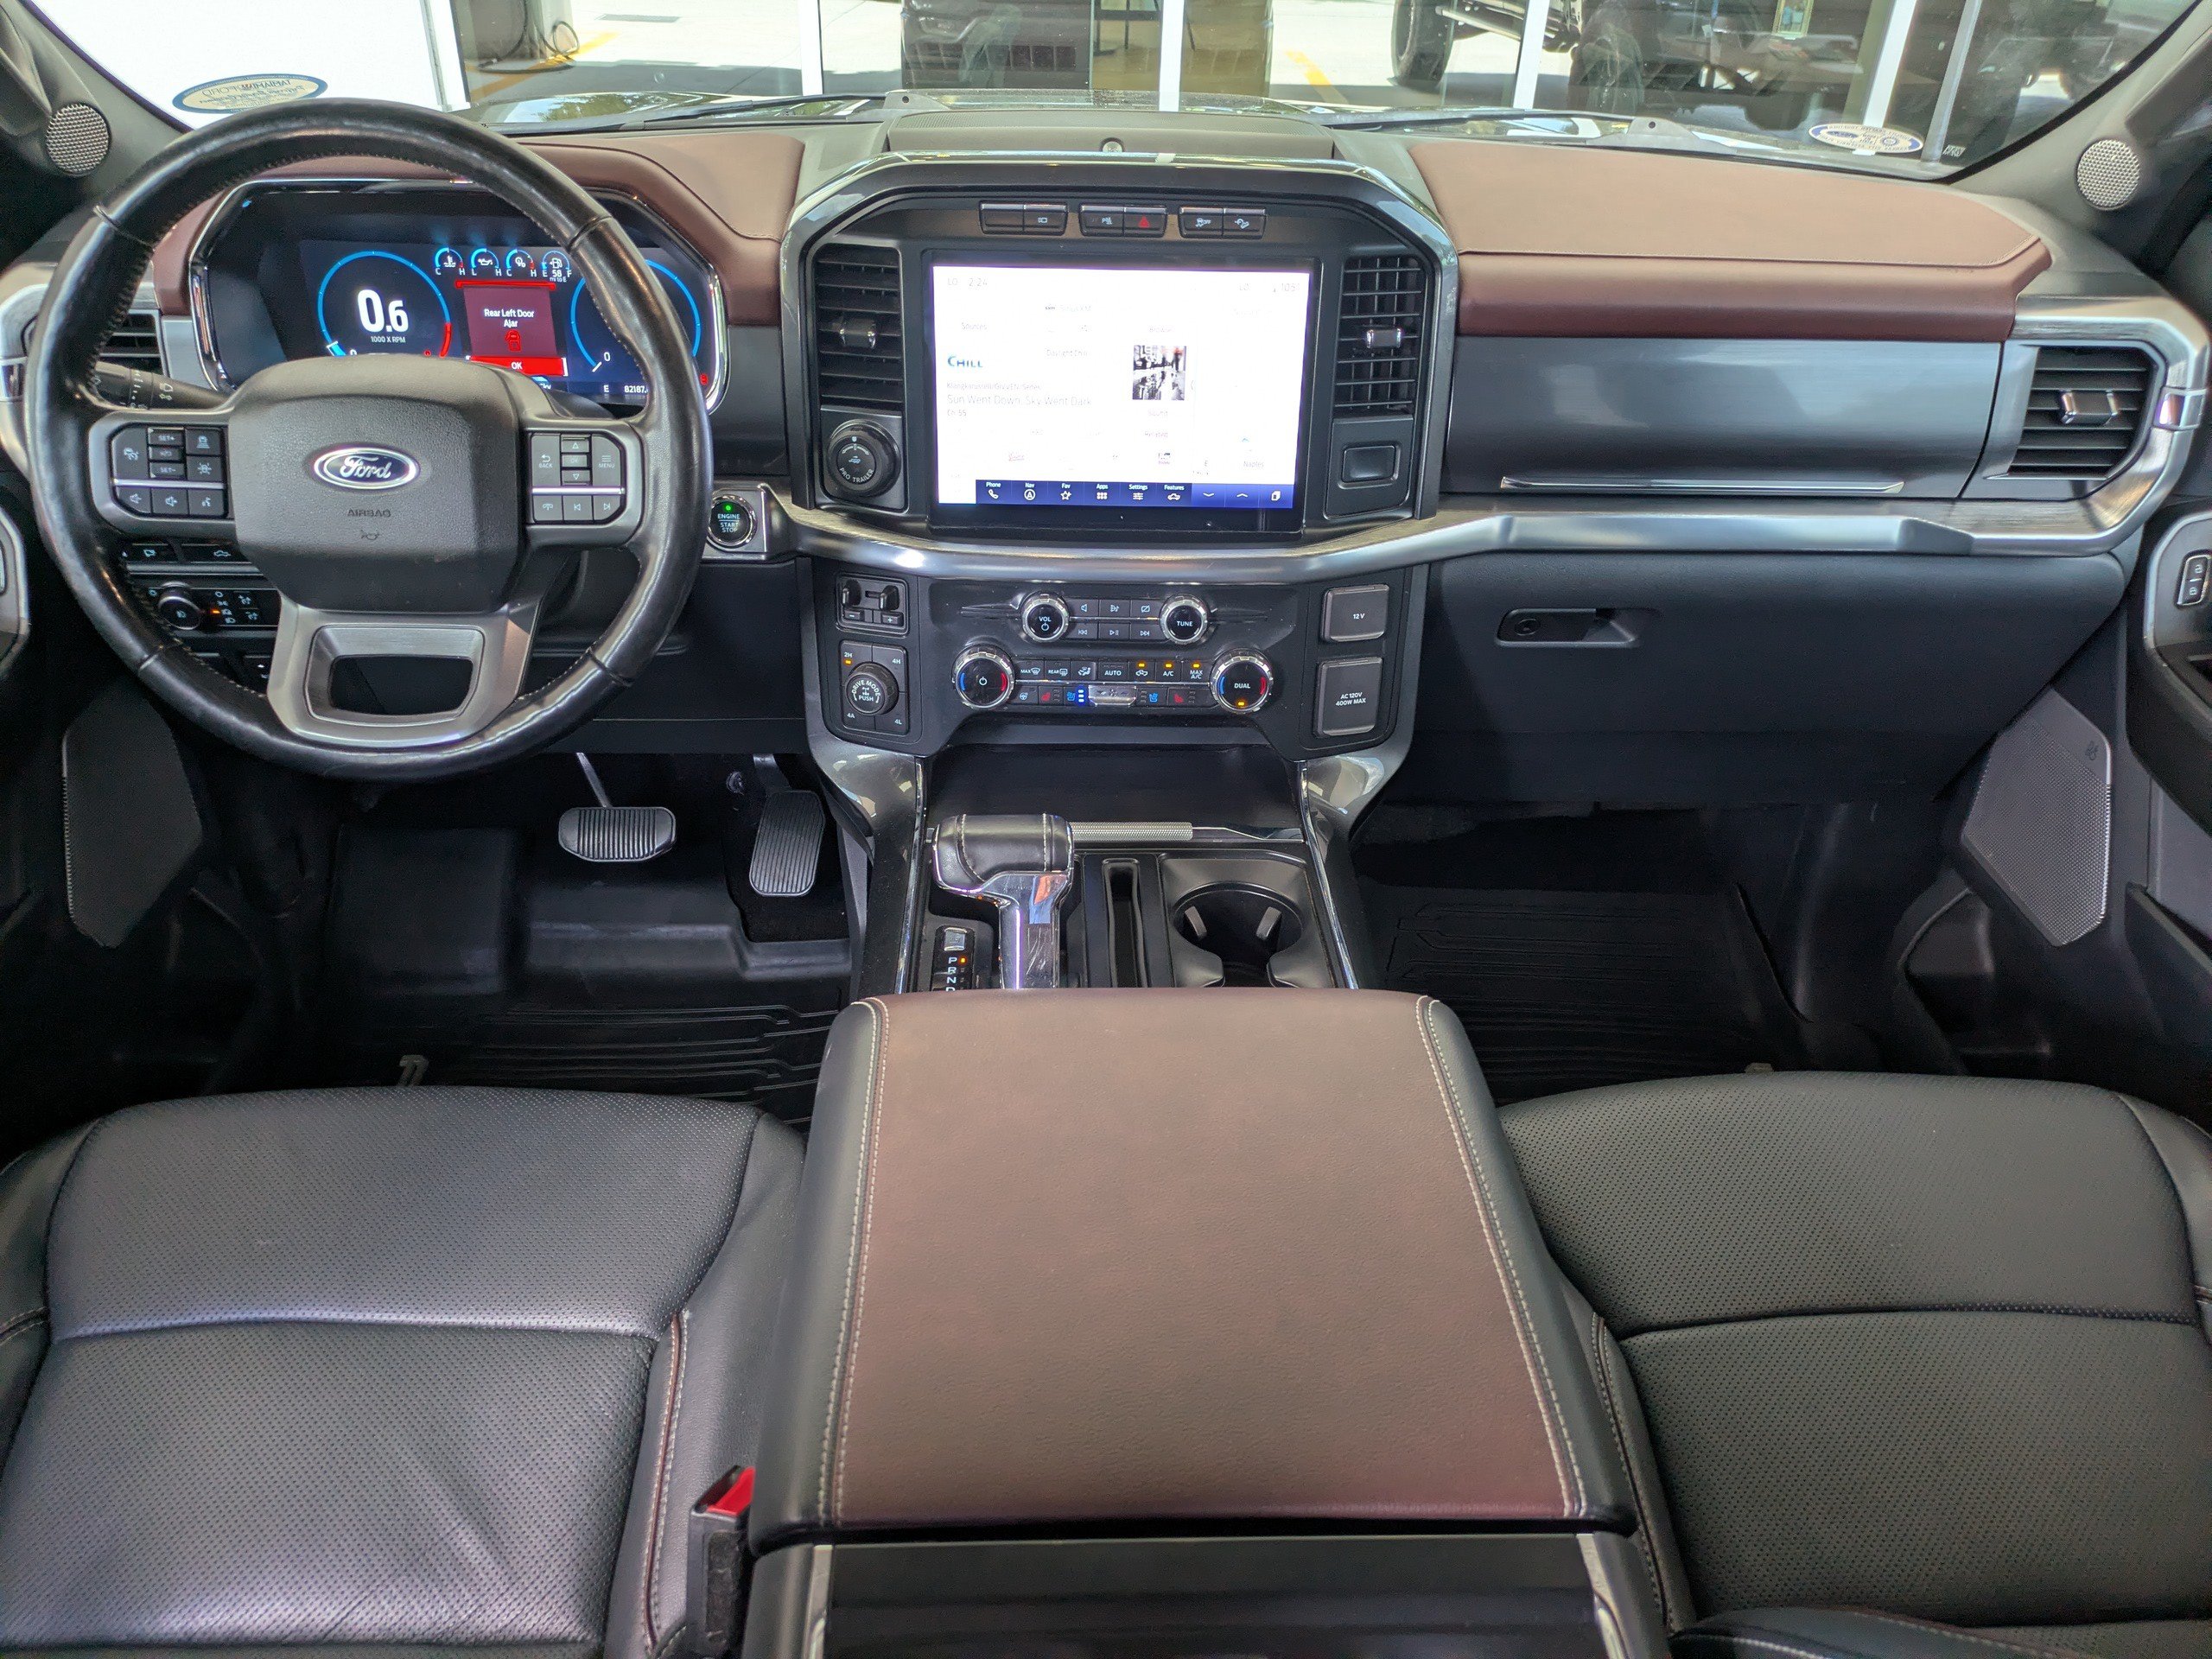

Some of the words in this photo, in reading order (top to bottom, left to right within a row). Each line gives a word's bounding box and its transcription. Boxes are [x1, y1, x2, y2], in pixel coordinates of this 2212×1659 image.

[551, 269, 563, 277] 58
[357, 289, 409, 333] 0.6
[484, 308, 501, 317] Rear
[501, 308, 517, 317] Left
[517, 309, 535, 318] Door
[503, 319, 518, 328] Ajar
[603, 352, 611, 362] 0
[511, 361, 523, 370] OK
[603, 385, 609, 393] E
[624, 385, 649, 393] 82187.
[339, 454, 392, 479] Ford
[839, 467, 851, 480] PRO
[852, 468, 874, 483] TRAILER
[346, 508, 392, 518] AIRBAG
[851, 680, 866, 695] DRIVE
[865, 680, 881, 696] MODE
[947, 966, 957, 975] R
